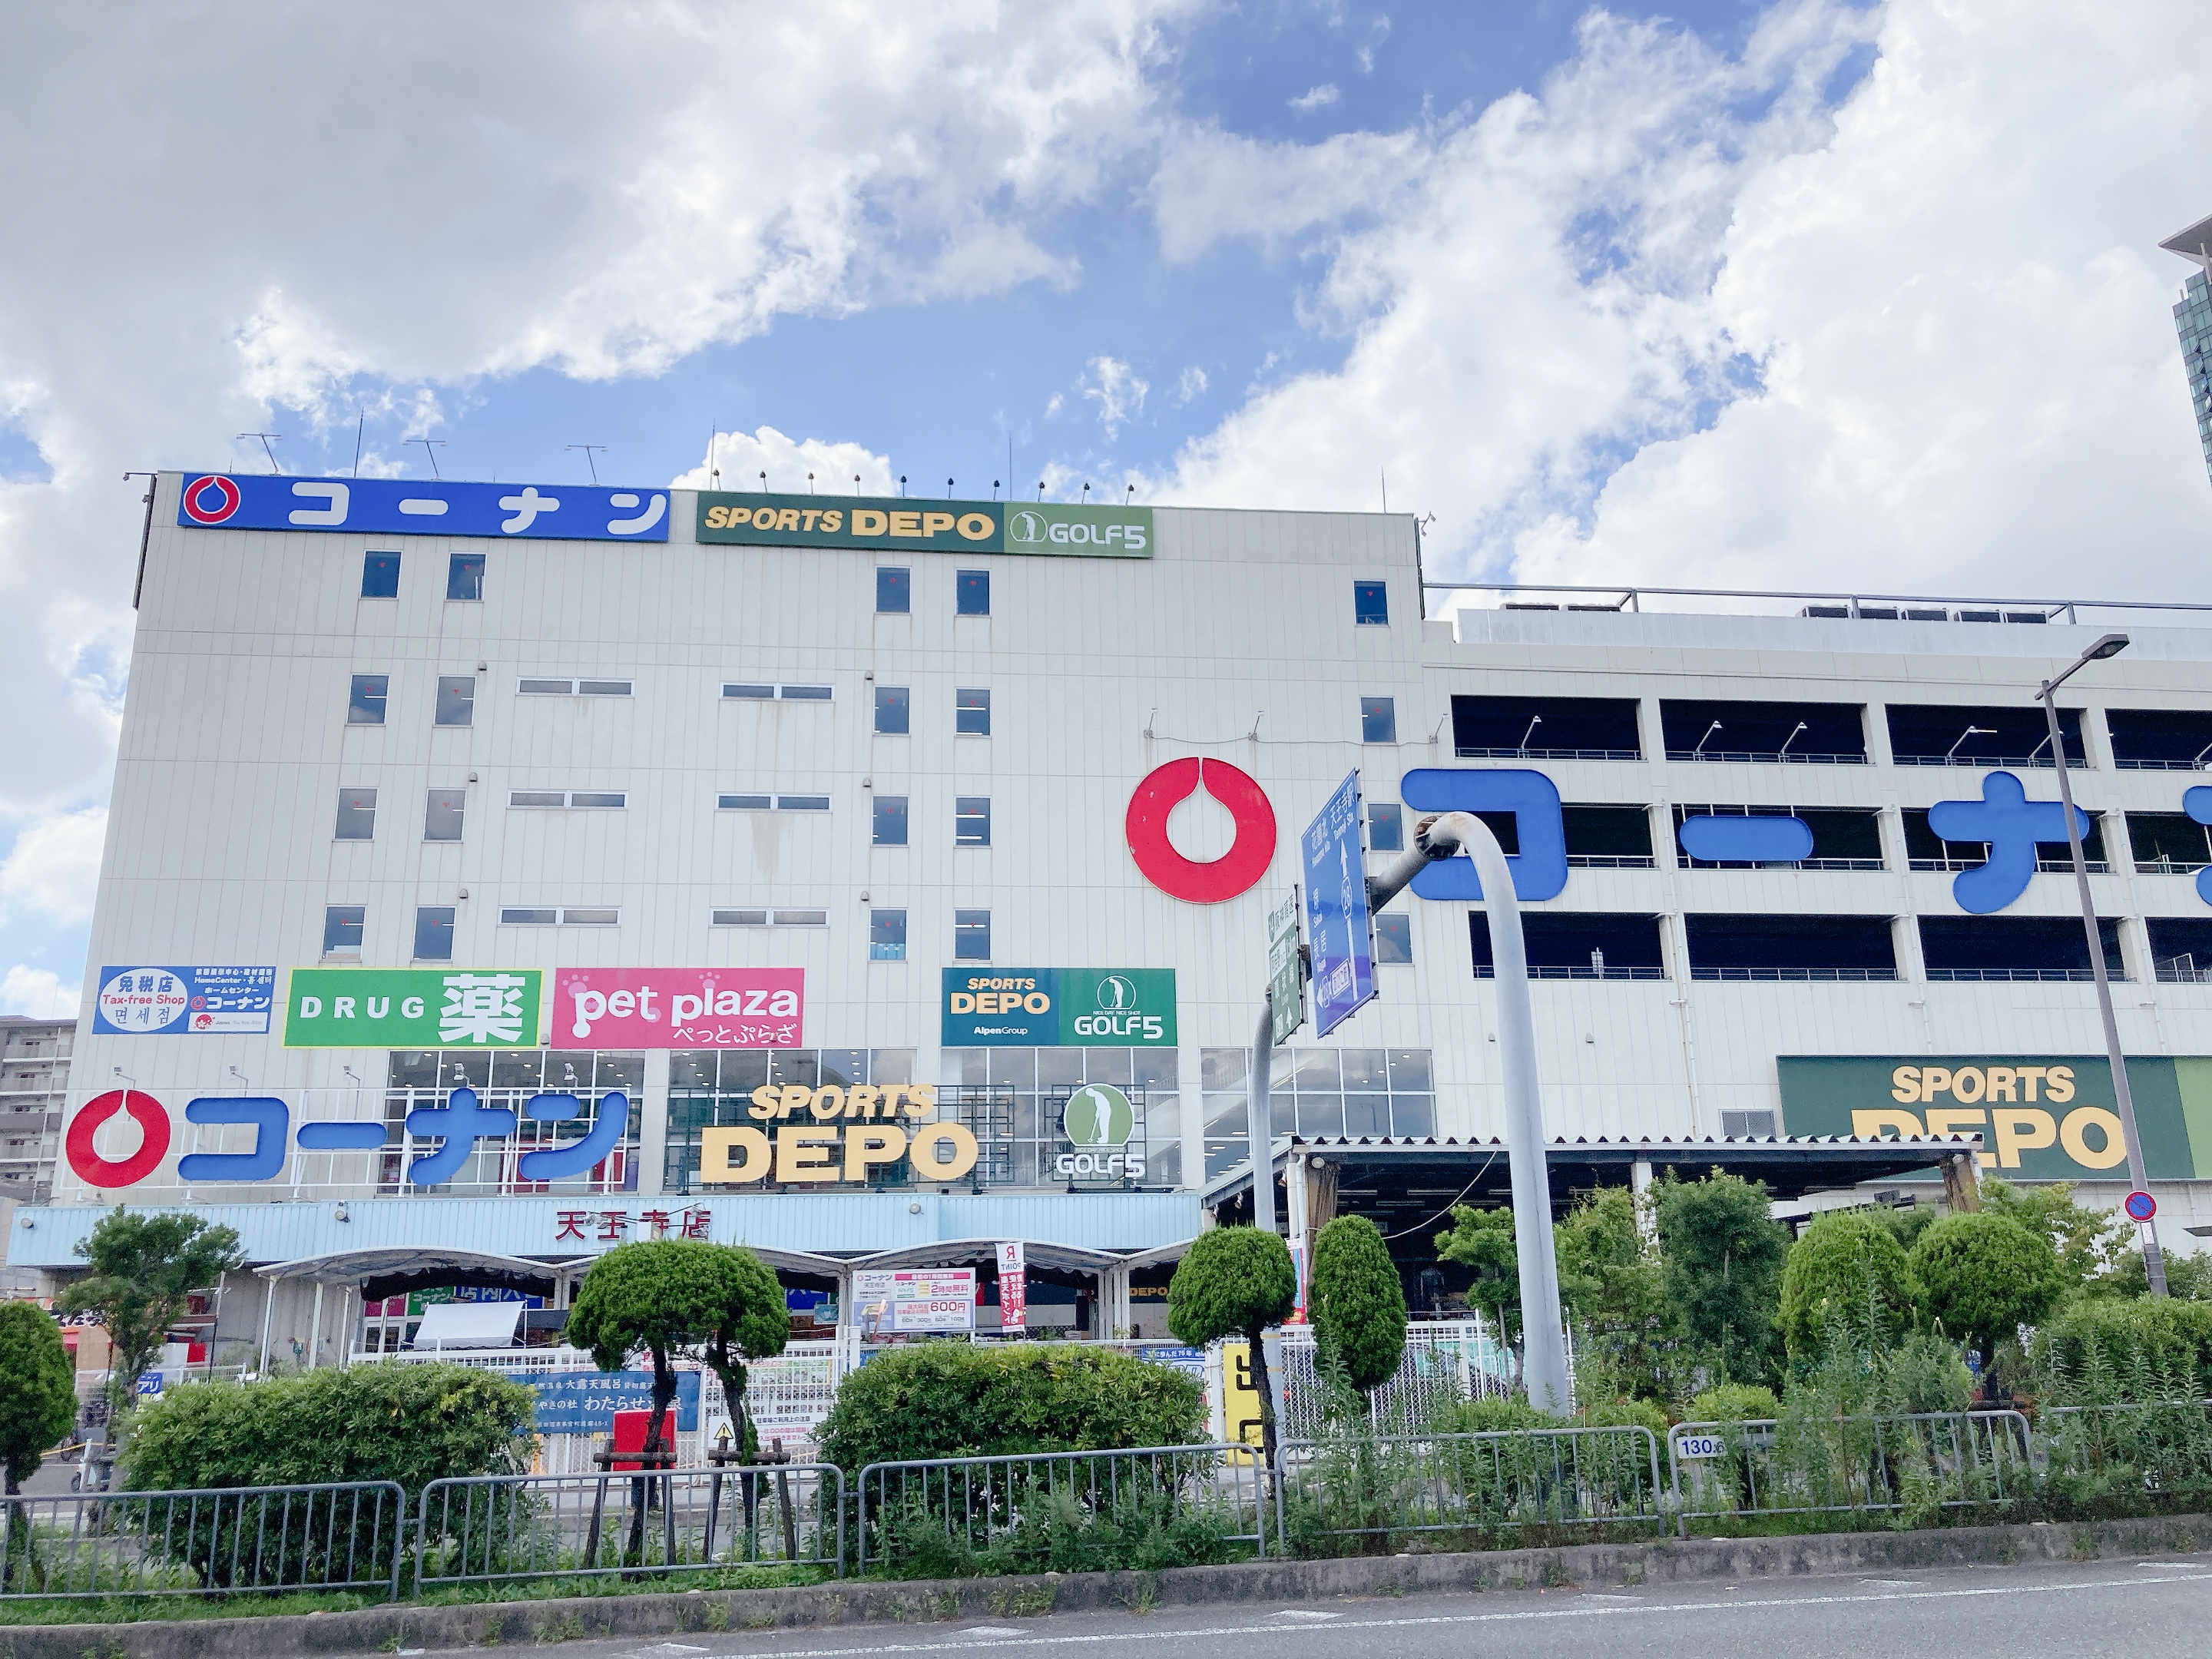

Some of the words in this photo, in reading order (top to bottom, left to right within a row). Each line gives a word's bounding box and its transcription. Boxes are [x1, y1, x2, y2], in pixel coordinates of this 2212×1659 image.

[289, 482, 666, 535] コーナン
[705, 506, 843, 534] SPORTS
[850, 509, 996, 541] DEPO
[1049, 523, 1147, 550] GOLF5
[1330, 782, 1355, 830] 天王寺駅
[1401, 768, 2212, 914] コーナ
[1343, 886, 1351, 910] 28
[967, 978, 1036, 990] SPORTS
[103, 995, 152, 1005] Tax-free
[157, 995, 185, 1005] Shop
[207, 996, 270, 1009] コーナン
[300, 996, 426, 1019] DRUG
[439, 973, 525, 1044] 薬
[572, 985, 658, 1038] pet
[671, 987, 798, 1026] plaza
[950, 992, 1050, 1015] DEPO
[674, 1023, 799, 1045] ぺっとぷらざ
[973, 1026, 1028, 1035] AlpenGroup
[1074, 1015, 1163, 1039] GOLF5
[1891, 1065, 2075, 1104] SPORTS
[747, 1084, 937, 1120] SPORTS
[178, 1088, 628, 1186] コーナン
[701, 1122, 979, 1183] DEPO
[1056, 1153, 1146, 1178] GOLF5
[555, 1209, 710, 1240] 天王寺店
[1130, 1286, 1168, 1296] DEPO
[931, 1302, 965, 1311] 600円
[566, 1379, 621, 1389] 大露天風呂
[1682, 1439, 1724, 1455] 130.6
